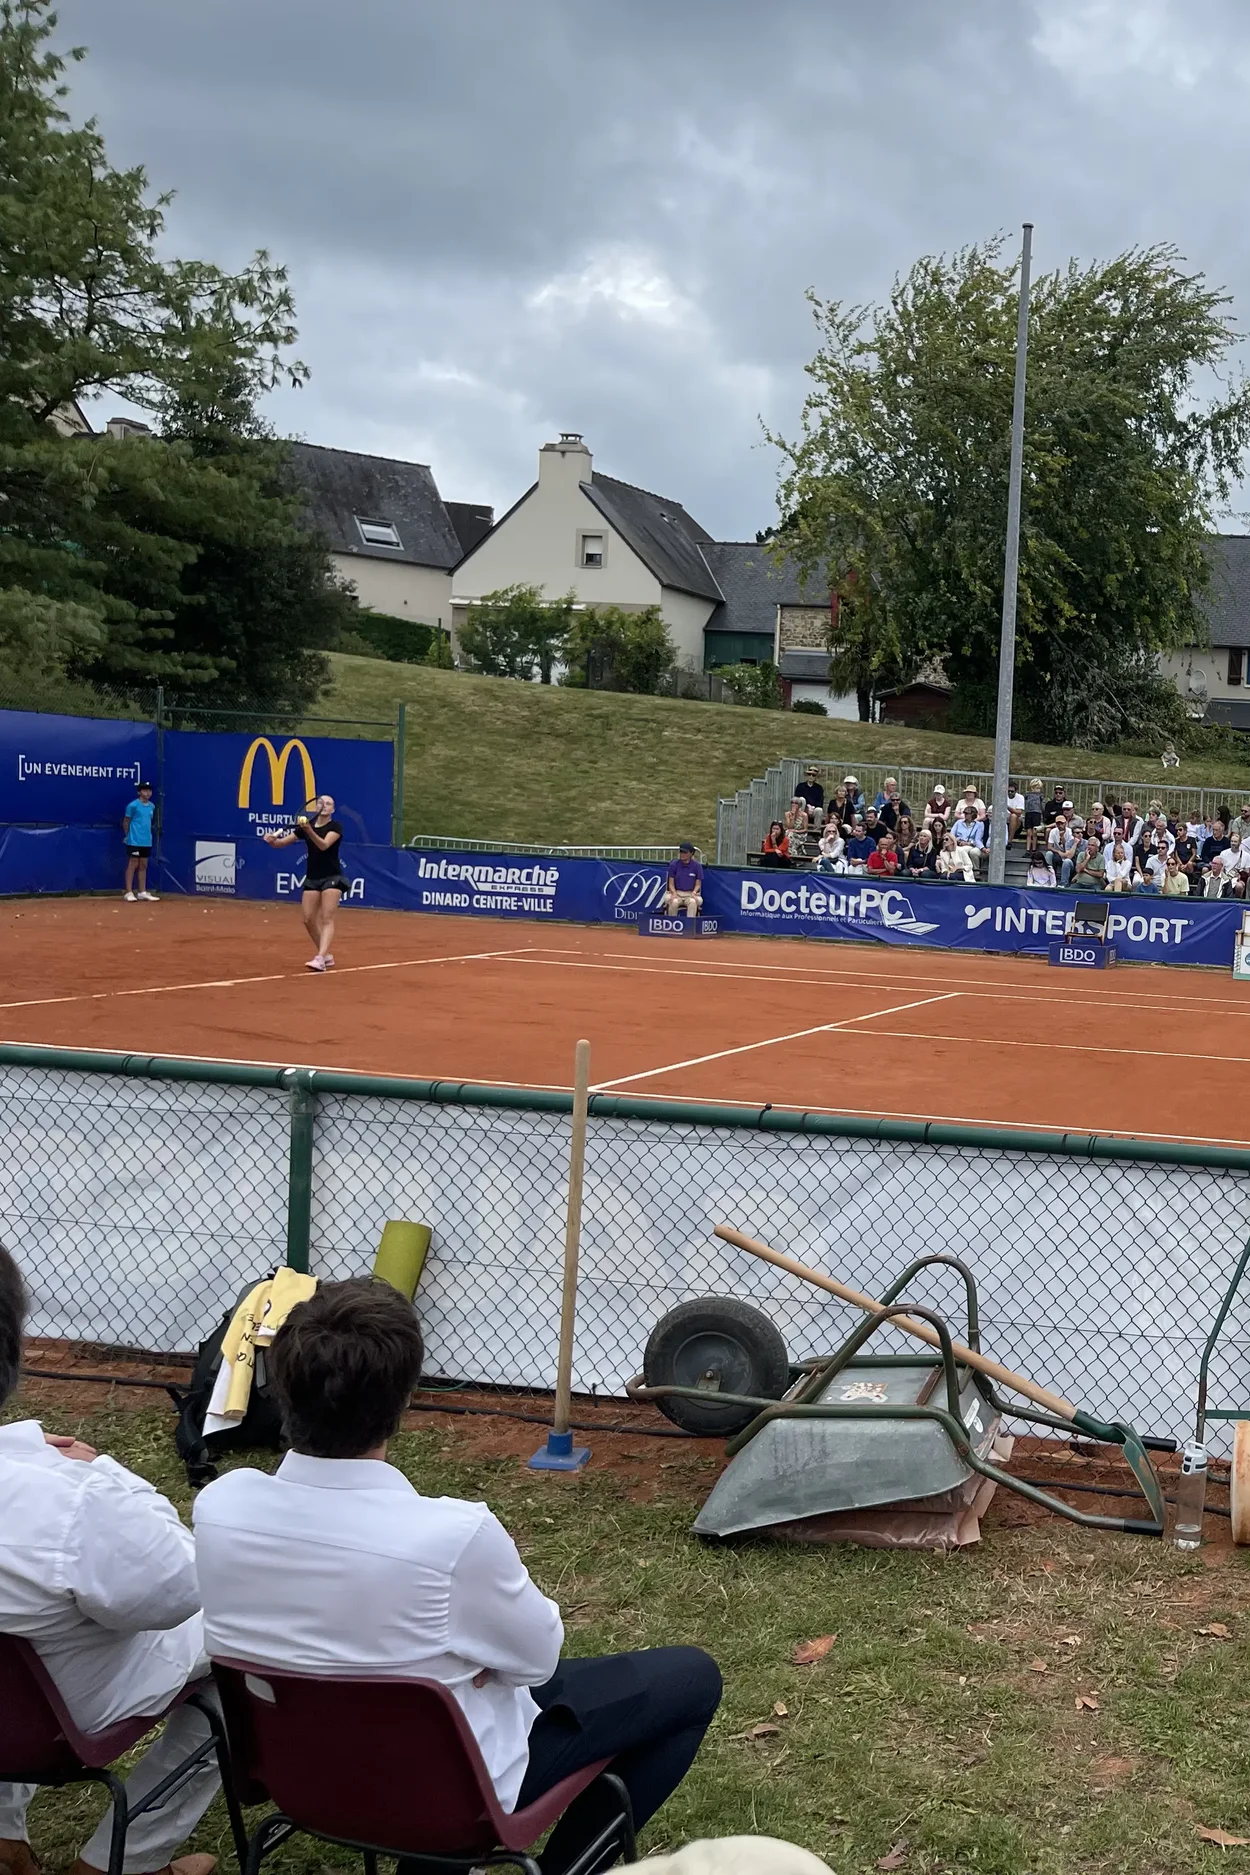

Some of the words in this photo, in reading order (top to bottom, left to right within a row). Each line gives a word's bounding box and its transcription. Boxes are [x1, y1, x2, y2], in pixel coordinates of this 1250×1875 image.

[490, 885, 544, 893] EXPRESS
[422, 891, 469, 907] DINARD
[473, 895, 553, 912] CENTRE-VILLE
[741, 881, 903, 920] DocteurPC
[653, 919, 684, 932] BDO
[740, 910, 781, 919] Informatique
[794, 913, 839, 923] Professionnels
[847, 917, 883, 926] Particuliers
[1064, 948, 1096, 962] BDO
